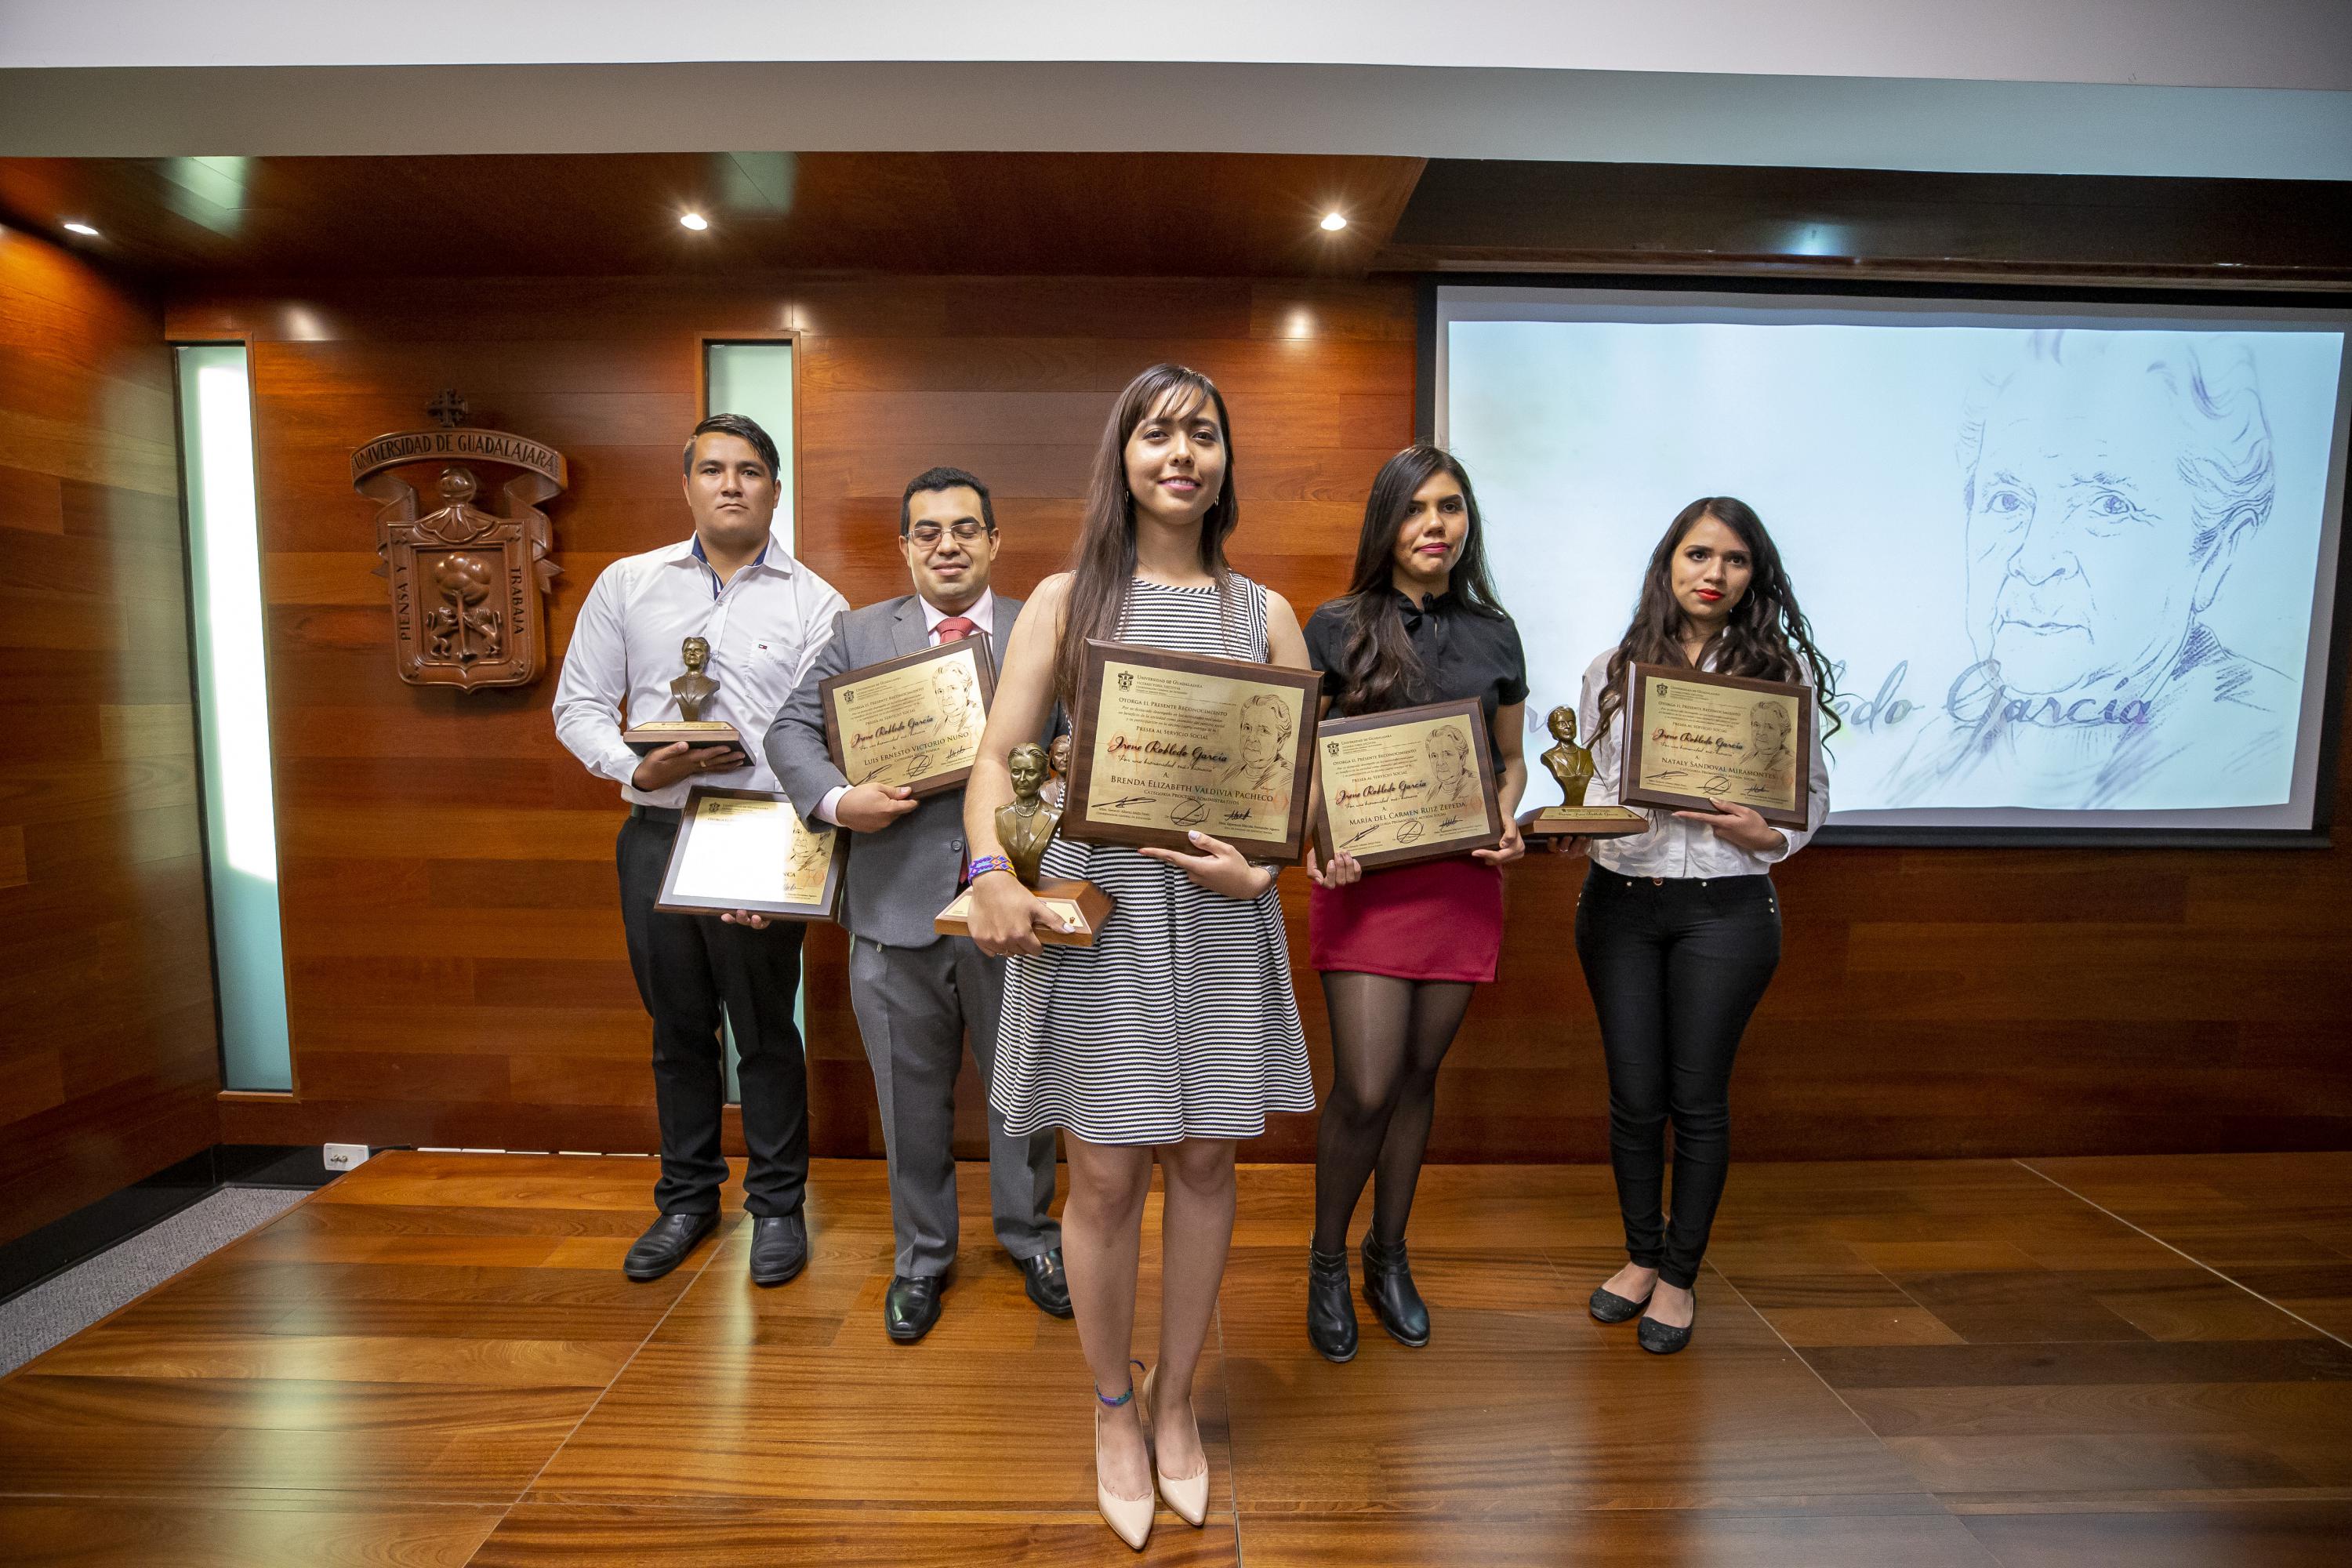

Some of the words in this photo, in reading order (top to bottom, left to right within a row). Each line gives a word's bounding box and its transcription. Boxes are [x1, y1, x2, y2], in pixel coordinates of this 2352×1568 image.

[354, 435, 430, 470] UNIVERSIDAD
[437, 434, 453, 452] DE
[458, 435, 556, 469] GUADALAJARA
[397, 583, 411, 641] PIENSA
[511, 566, 524, 634] TRABAJA
[1178, 706, 1227, 716] RECONOCIMIENTO
[851, 734, 873, 748] Irene
[876, 722, 904, 737] Robledo
[908, 716, 933, 735] García
[1653, 728, 1678, 740] Irene
[1680, 732, 1713, 745] Robledo
[1716, 738, 1744, 753] García
[864, 757, 879, 766] LUIS
[881, 749, 910, 761] ERNESTO
[911, 739, 946, 752] VICTORIO
[1108, 736, 1142, 753] Irene
[1145, 740, 1189, 757] Robledo
[1192, 746, 1228, 766] García
[1662, 757, 1688, 766] NATALY
[1690, 761, 1727, 772] SANDOVAL
[1729, 768, 1776, 779] MIRAMONTES
[1111, 775, 1145, 786] BRENDA
[1149, 780, 1192, 792] ELIZABETH
[1195, 785, 1232, 797] VALDIVIA
[1235, 792, 1273, 802] PACHECO
[1196, 796, 1239, 804] ADMINISTRATIVOS
[1336, 790, 1360, 804] Irene
[1363, 783, 1396, 797] Robledo
[1399, 780, 1426, 797] García
[1349, 816, 1372, 826] MARÍA
[1389, 809, 1418, 819] CARMEN
[1440, 801, 1465, 811] ZEPEDA
